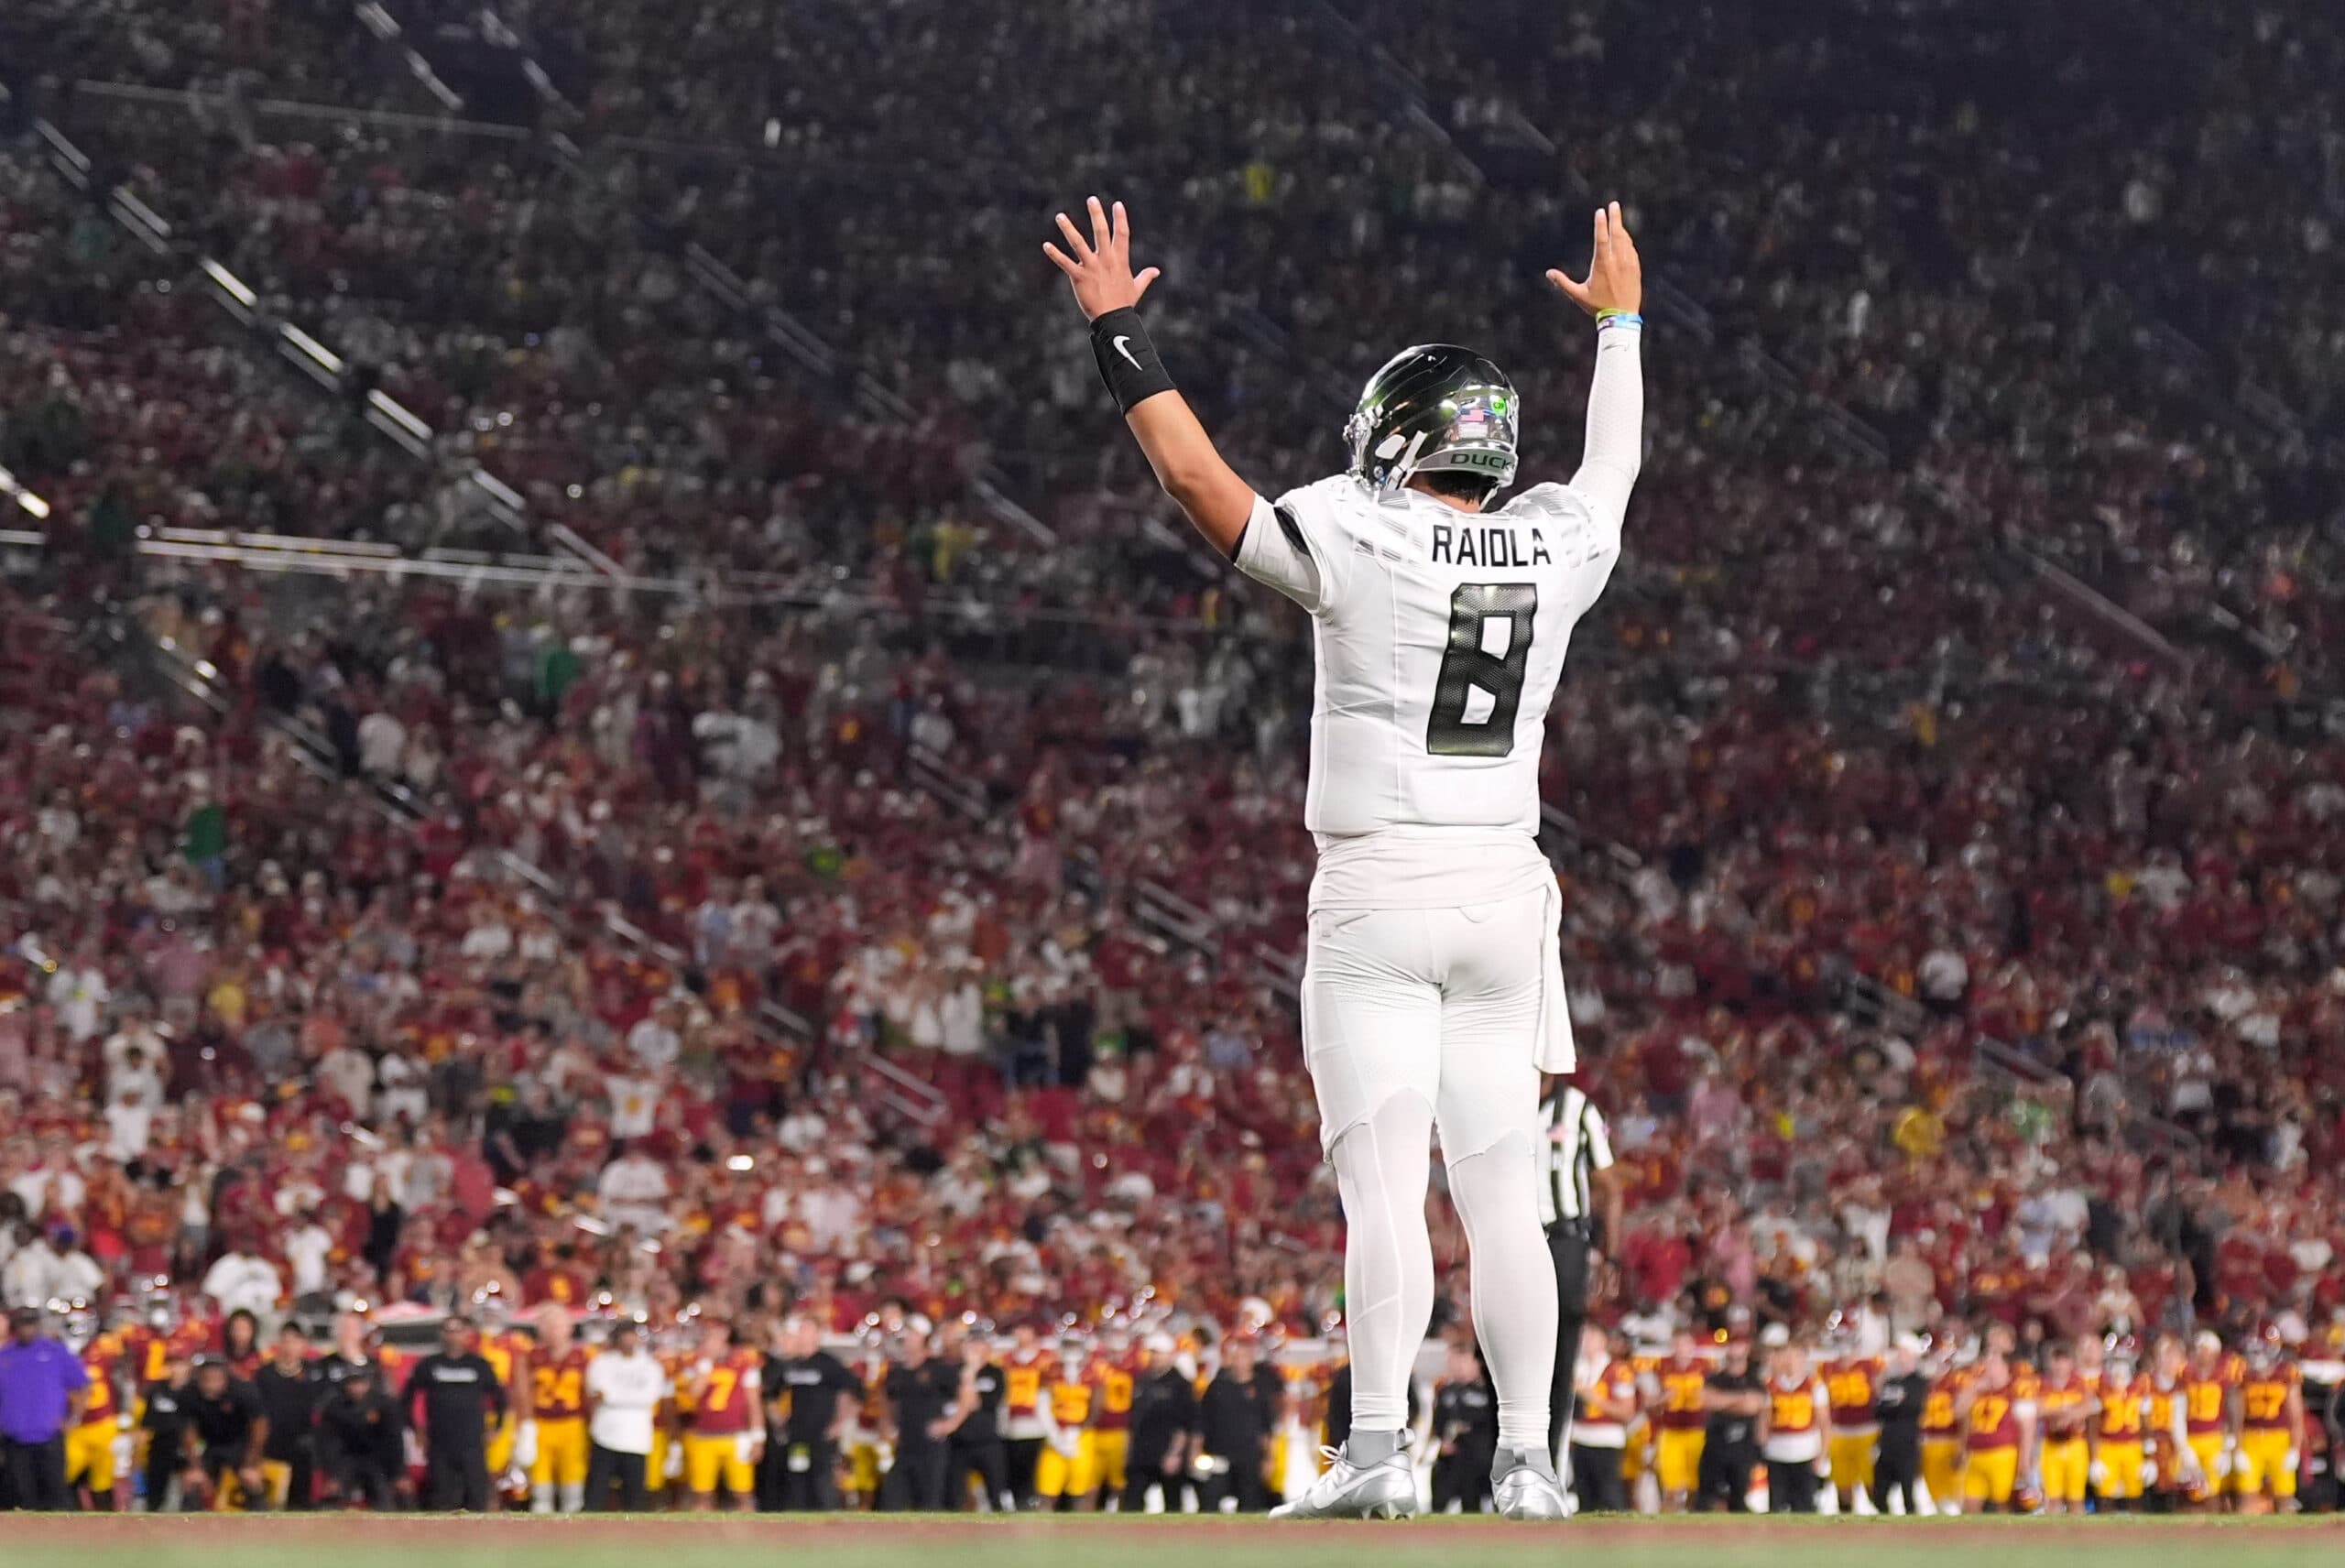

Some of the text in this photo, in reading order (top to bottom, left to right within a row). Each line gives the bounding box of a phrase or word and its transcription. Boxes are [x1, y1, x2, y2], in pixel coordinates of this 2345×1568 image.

[1450, 453, 1514, 470] DUCK
[1432, 524, 1552, 567] RAIOLA
[1426, 583, 1538, 757] 8
[533, 1367, 583, 1410] 24
[705, 1367, 737, 1411] 7
